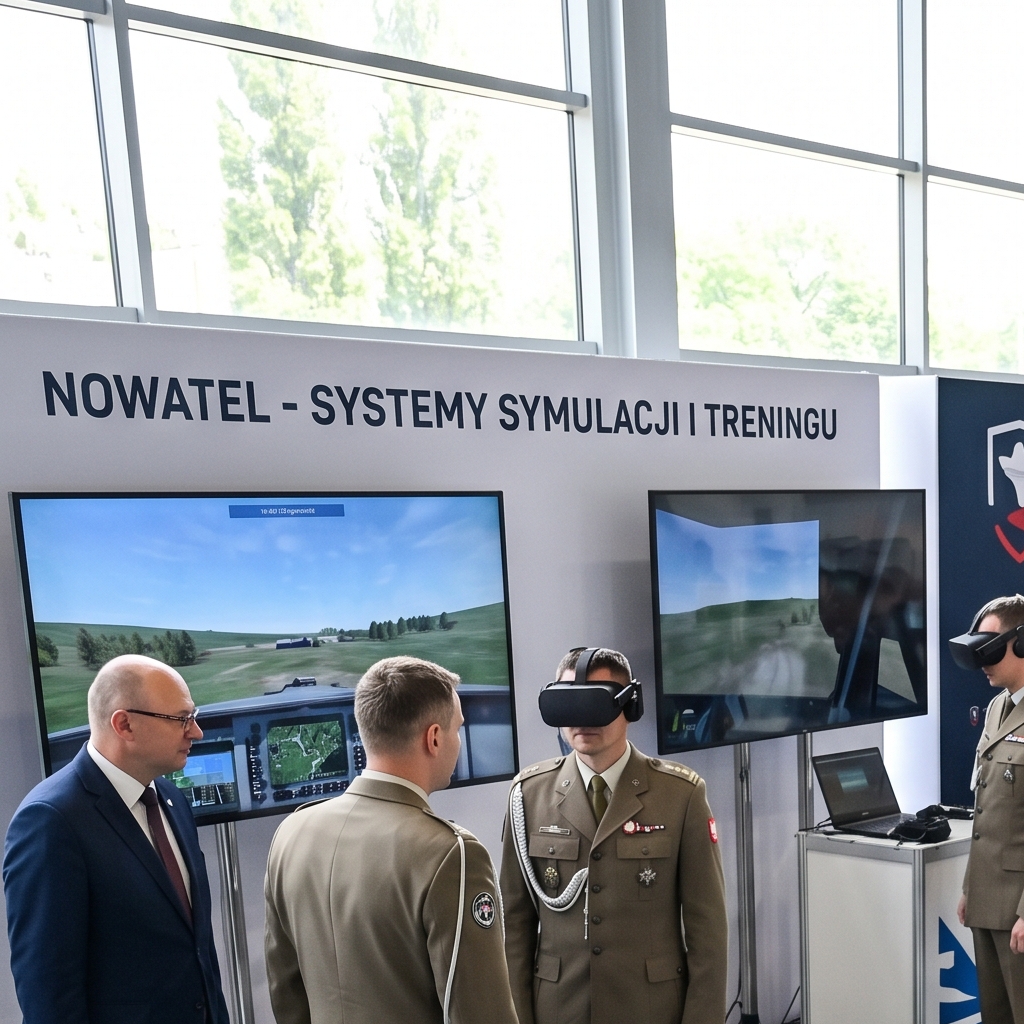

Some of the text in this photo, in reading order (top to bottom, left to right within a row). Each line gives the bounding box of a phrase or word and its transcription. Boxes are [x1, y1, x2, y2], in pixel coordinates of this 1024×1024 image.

[42, 370, 837, 441] NOWATEL - SYSTEMY SYMULACJI I TRENINGU
